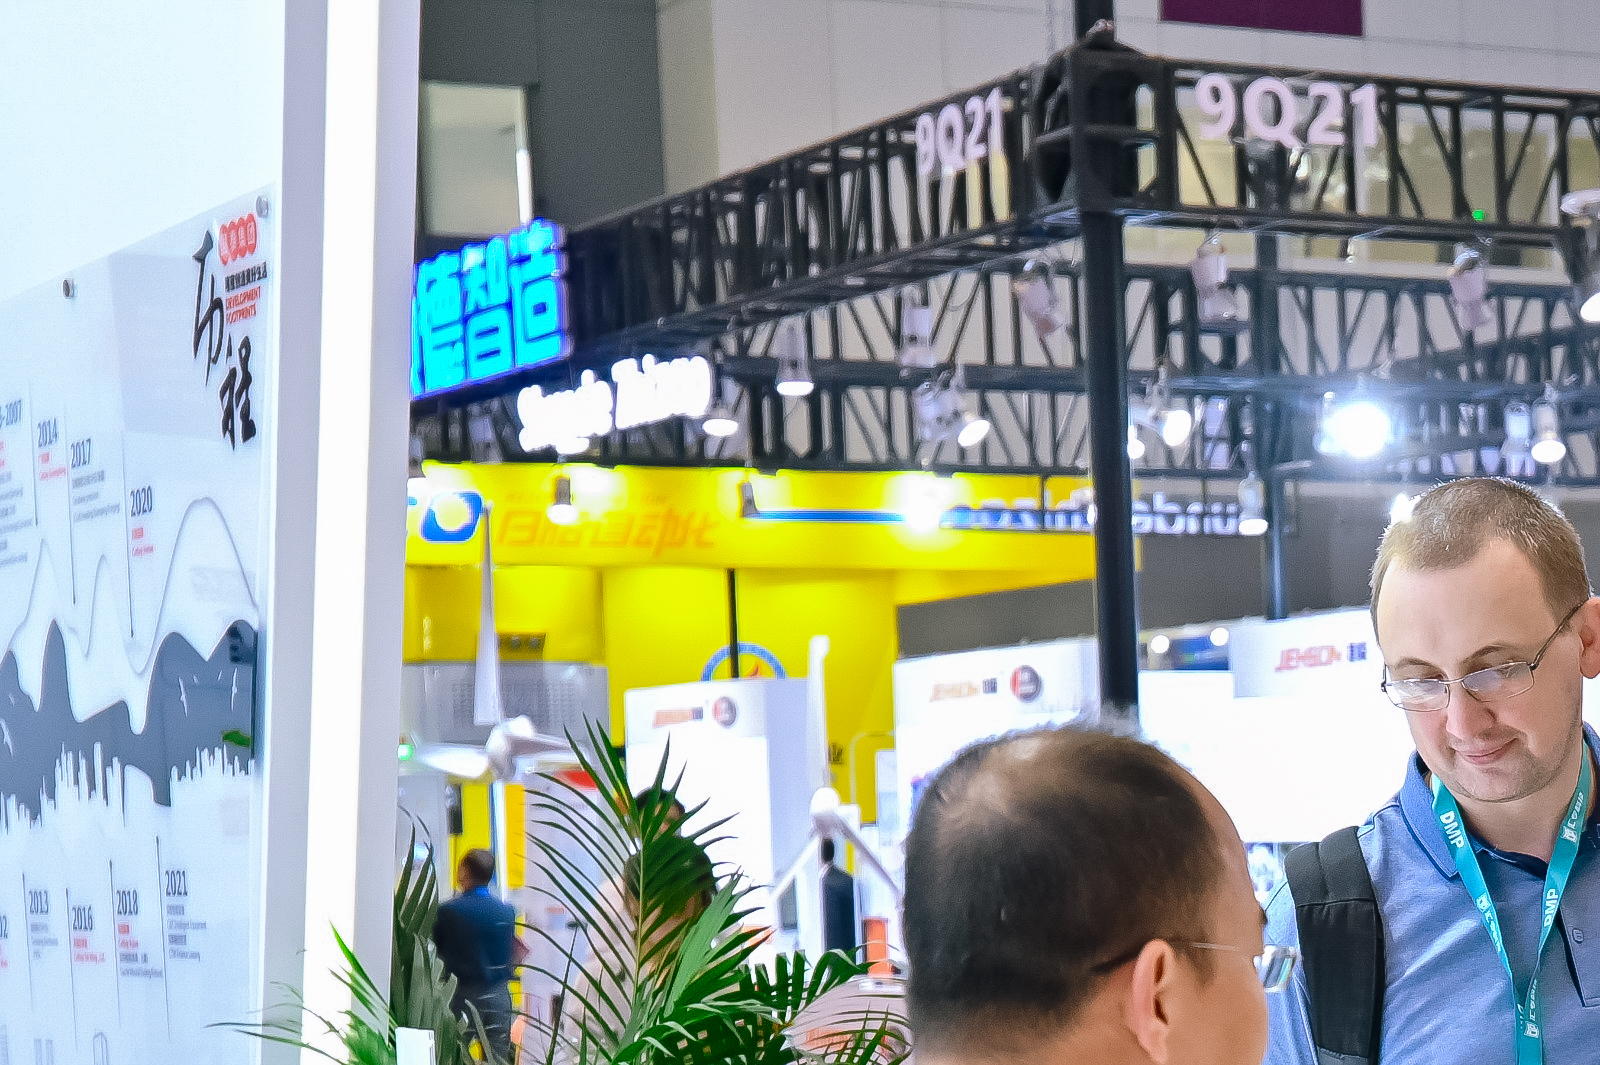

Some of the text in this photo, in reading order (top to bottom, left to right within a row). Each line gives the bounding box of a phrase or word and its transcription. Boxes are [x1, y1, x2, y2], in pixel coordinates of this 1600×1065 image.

[1196, 73, 1379, 149] 9Q21
[915, 87, 1003, 176] 9Q21
[411, 217, 570, 400] 德智造
[38, 417, 58, 448] 2014
[71, 438, 92, 468] 2017
[130, 485, 153, 518] 2020
[1440, 810, 1464, 848] DMP
[165, 870, 188, 897] 2021
[29, 890, 49, 915] 2013
[72, 905, 94, 931] 2016
[117, 890, 139, 916] 2018
[1544, 888, 1559, 927] DMP
